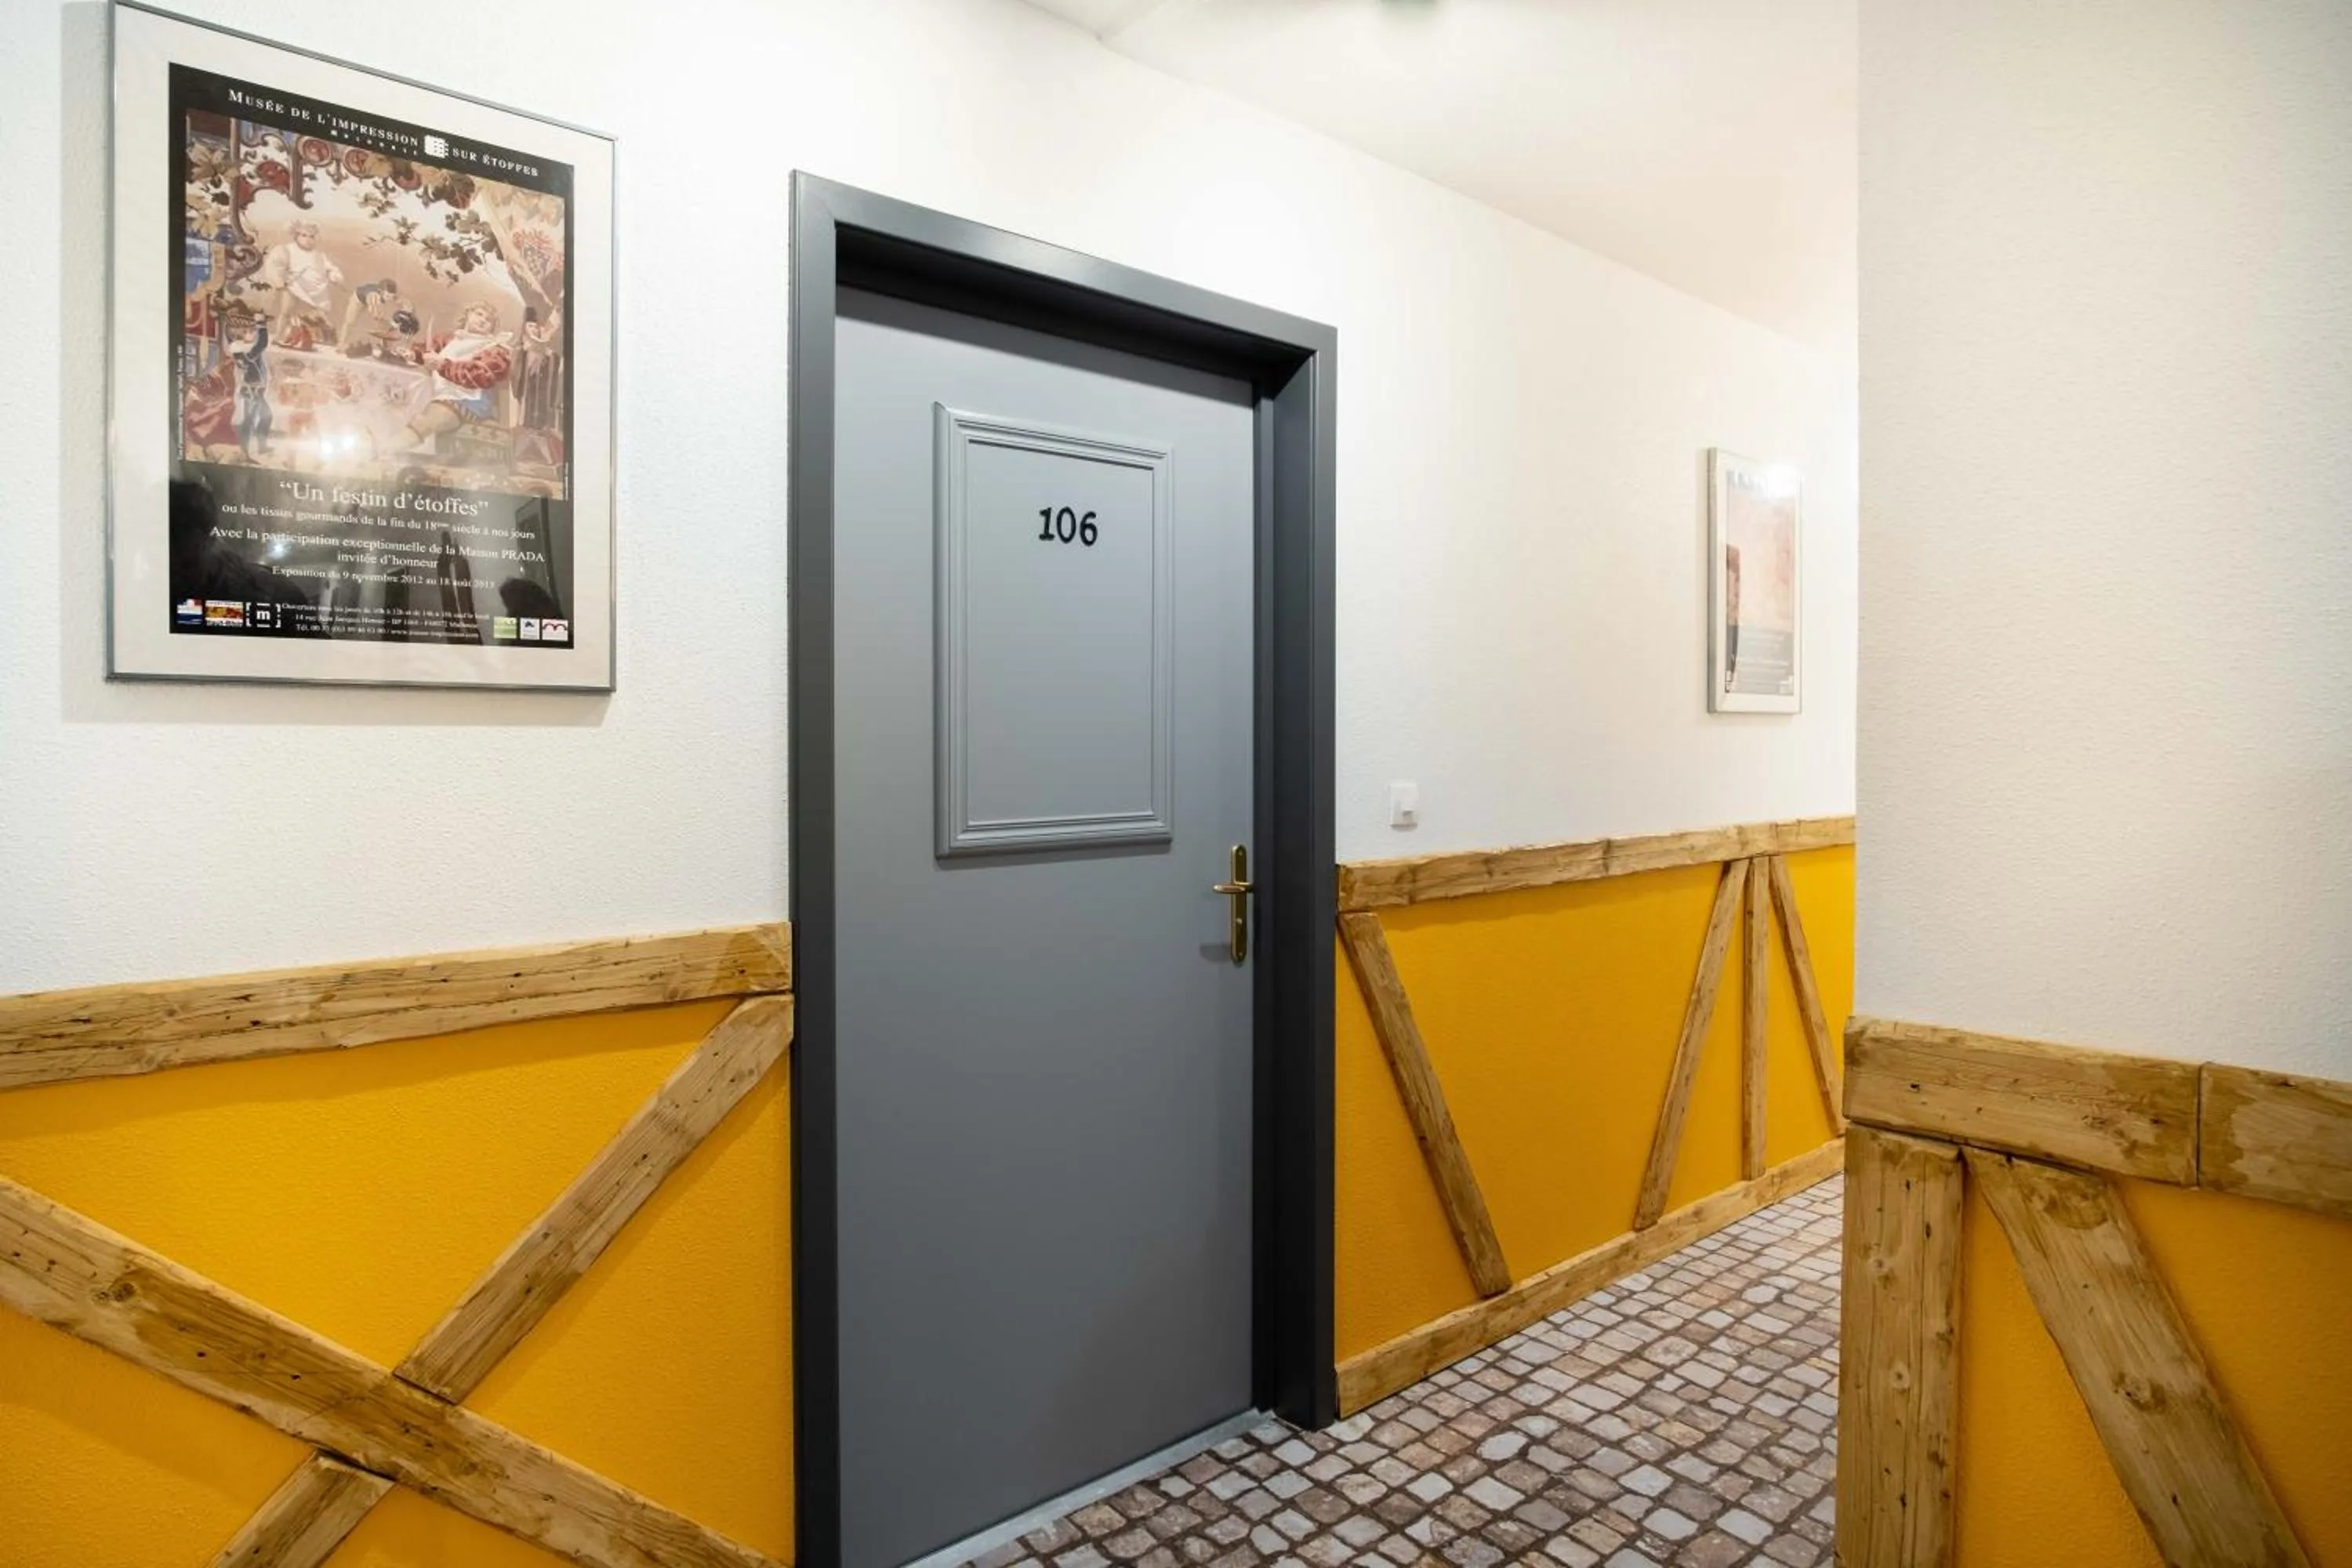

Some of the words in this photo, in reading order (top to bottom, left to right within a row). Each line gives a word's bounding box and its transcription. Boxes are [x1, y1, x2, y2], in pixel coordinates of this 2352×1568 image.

[228, 88, 285, 114] MUSÉE
[291, 107, 310, 120] DE
[318, 114, 418, 147] L'IMPRESSION
[452, 148, 477, 162] SUR
[483, 154, 539, 176] ÉTOFFES
[332, 483, 387, 507] festin
[222, 504, 237, 514] ou
[241, 504, 257, 515] les
[260, 506, 293, 518] tissus
[296, 512, 358, 525] gourmands
[361, 515, 373, 524] de
[377, 516, 387, 526] la
[390, 517, 405, 528] fin
[408, 518, 421, 529] du
[510, 528, 535, 539] jours
[1039, 506, 1098, 546] 106
[209, 526, 243, 539] Avec
[247, 528, 258, 539] la
[262, 532, 339, 546] participation
[343, 538, 426, 554] exceptionnelle
[429, 544, 443, 554] de
[446, 544, 456, 555] la
[459, 546, 499, 558] Maison
[501, 550, 545, 562] PRADA
[272, 565, 326, 579] Exposition
[352, 572, 398, 584] novembre
[401, 575, 423, 584] 2012
[338, 552, 377, 564] invitée
[380, 554, 438, 568] d'honneur
